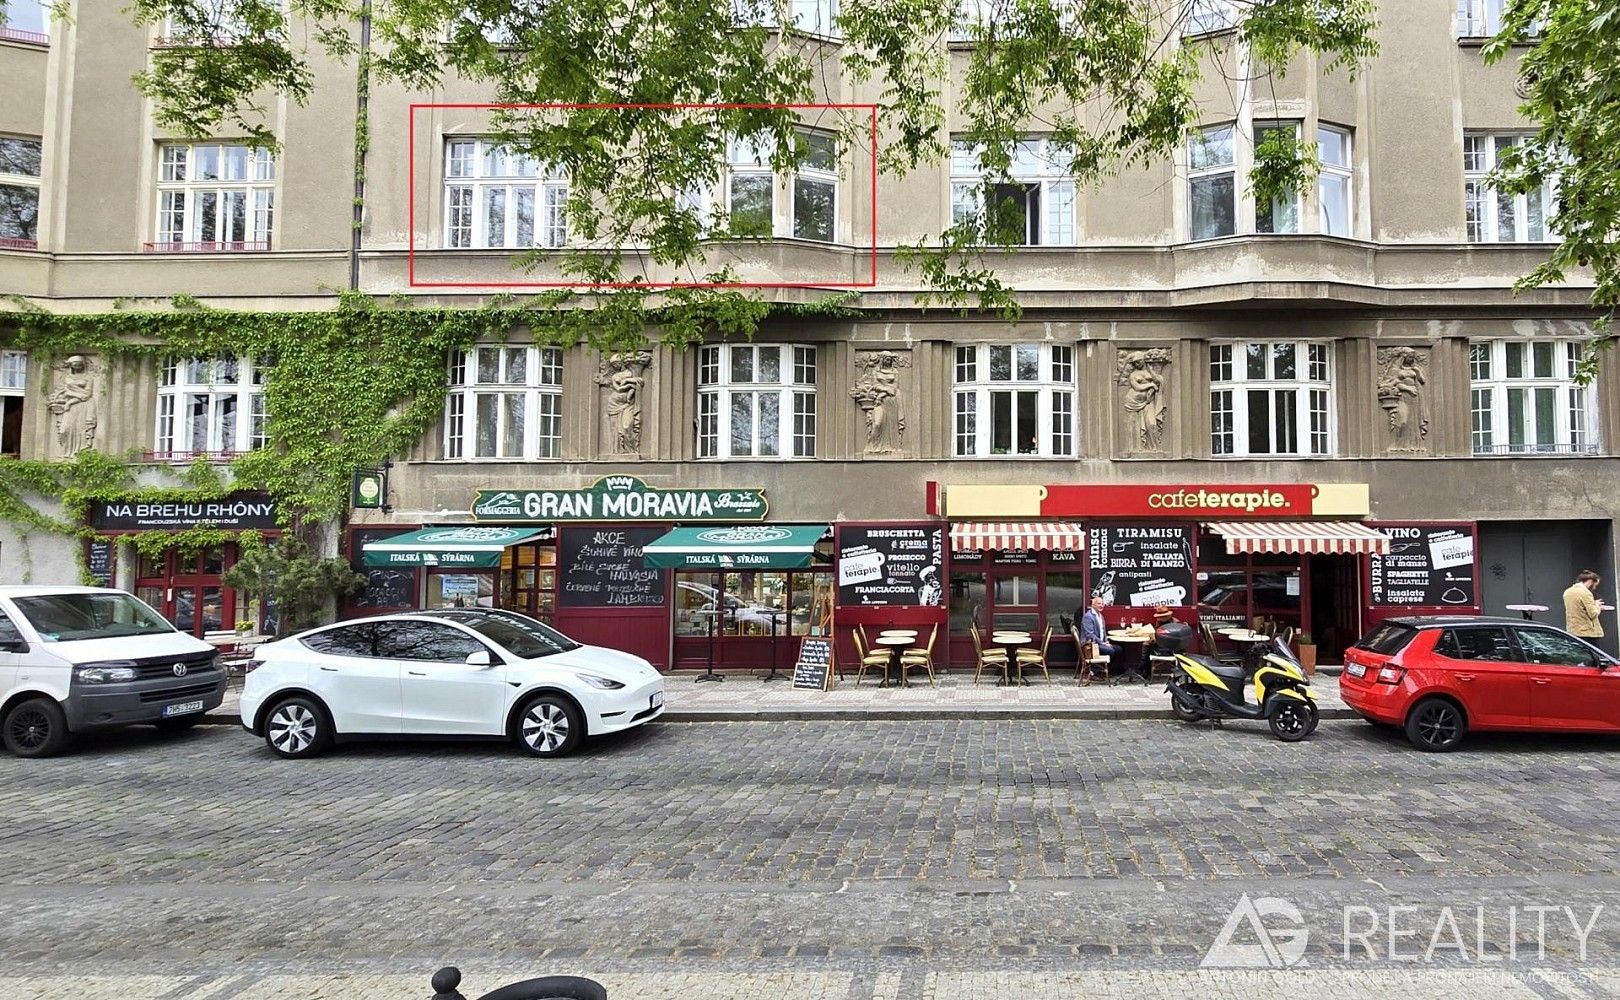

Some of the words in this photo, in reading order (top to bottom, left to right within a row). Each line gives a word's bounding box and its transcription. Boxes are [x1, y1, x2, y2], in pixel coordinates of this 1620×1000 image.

[106, 504, 133, 517] NA
[136, 502, 202, 517] BŘEHU
[206, 501, 274, 516] RHÔNY
[524, 492, 593, 517] GRAN
[602, 492, 714, 517] MORAVIA
[475, 506, 521, 515] FORMAGGERIA
[593, 531, 627, 545] AKCE
[866, 529, 926, 538] BRUSCHETTA
[1116, 528, 1183, 538] TIRAMISU
[1384, 527, 1421, 539] VINO
[932, 529, 942, 565] PASTA
[1089, 528, 1100, 569] pinsa
[1100, 528, 1108, 569] romana
[1140, 541, 1179, 550] insalate
[390, 553, 420, 562] ITALSKÁ
[441, 552, 475, 562] SÝRÁRNA
[685, 554, 716, 564] ITALSKÁ
[736, 554, 770, 564] SÝRÁRNA
[1052, 551, 1076, 561] KÁVA
[1385, 554, 1427, 562] carpaccio
[886, 562, 920, 572] vitello
[1110, 558, 1138, 568] BIRRA
[1140, 560, 1151, 568] DI
[1152, 560, 1185, 568] MANZO
[854, 586, 916, 594] FRANCIACORTA
[1386, 589, 1426, 597] insalata
[1387, 596, 1424, 604] caprese
